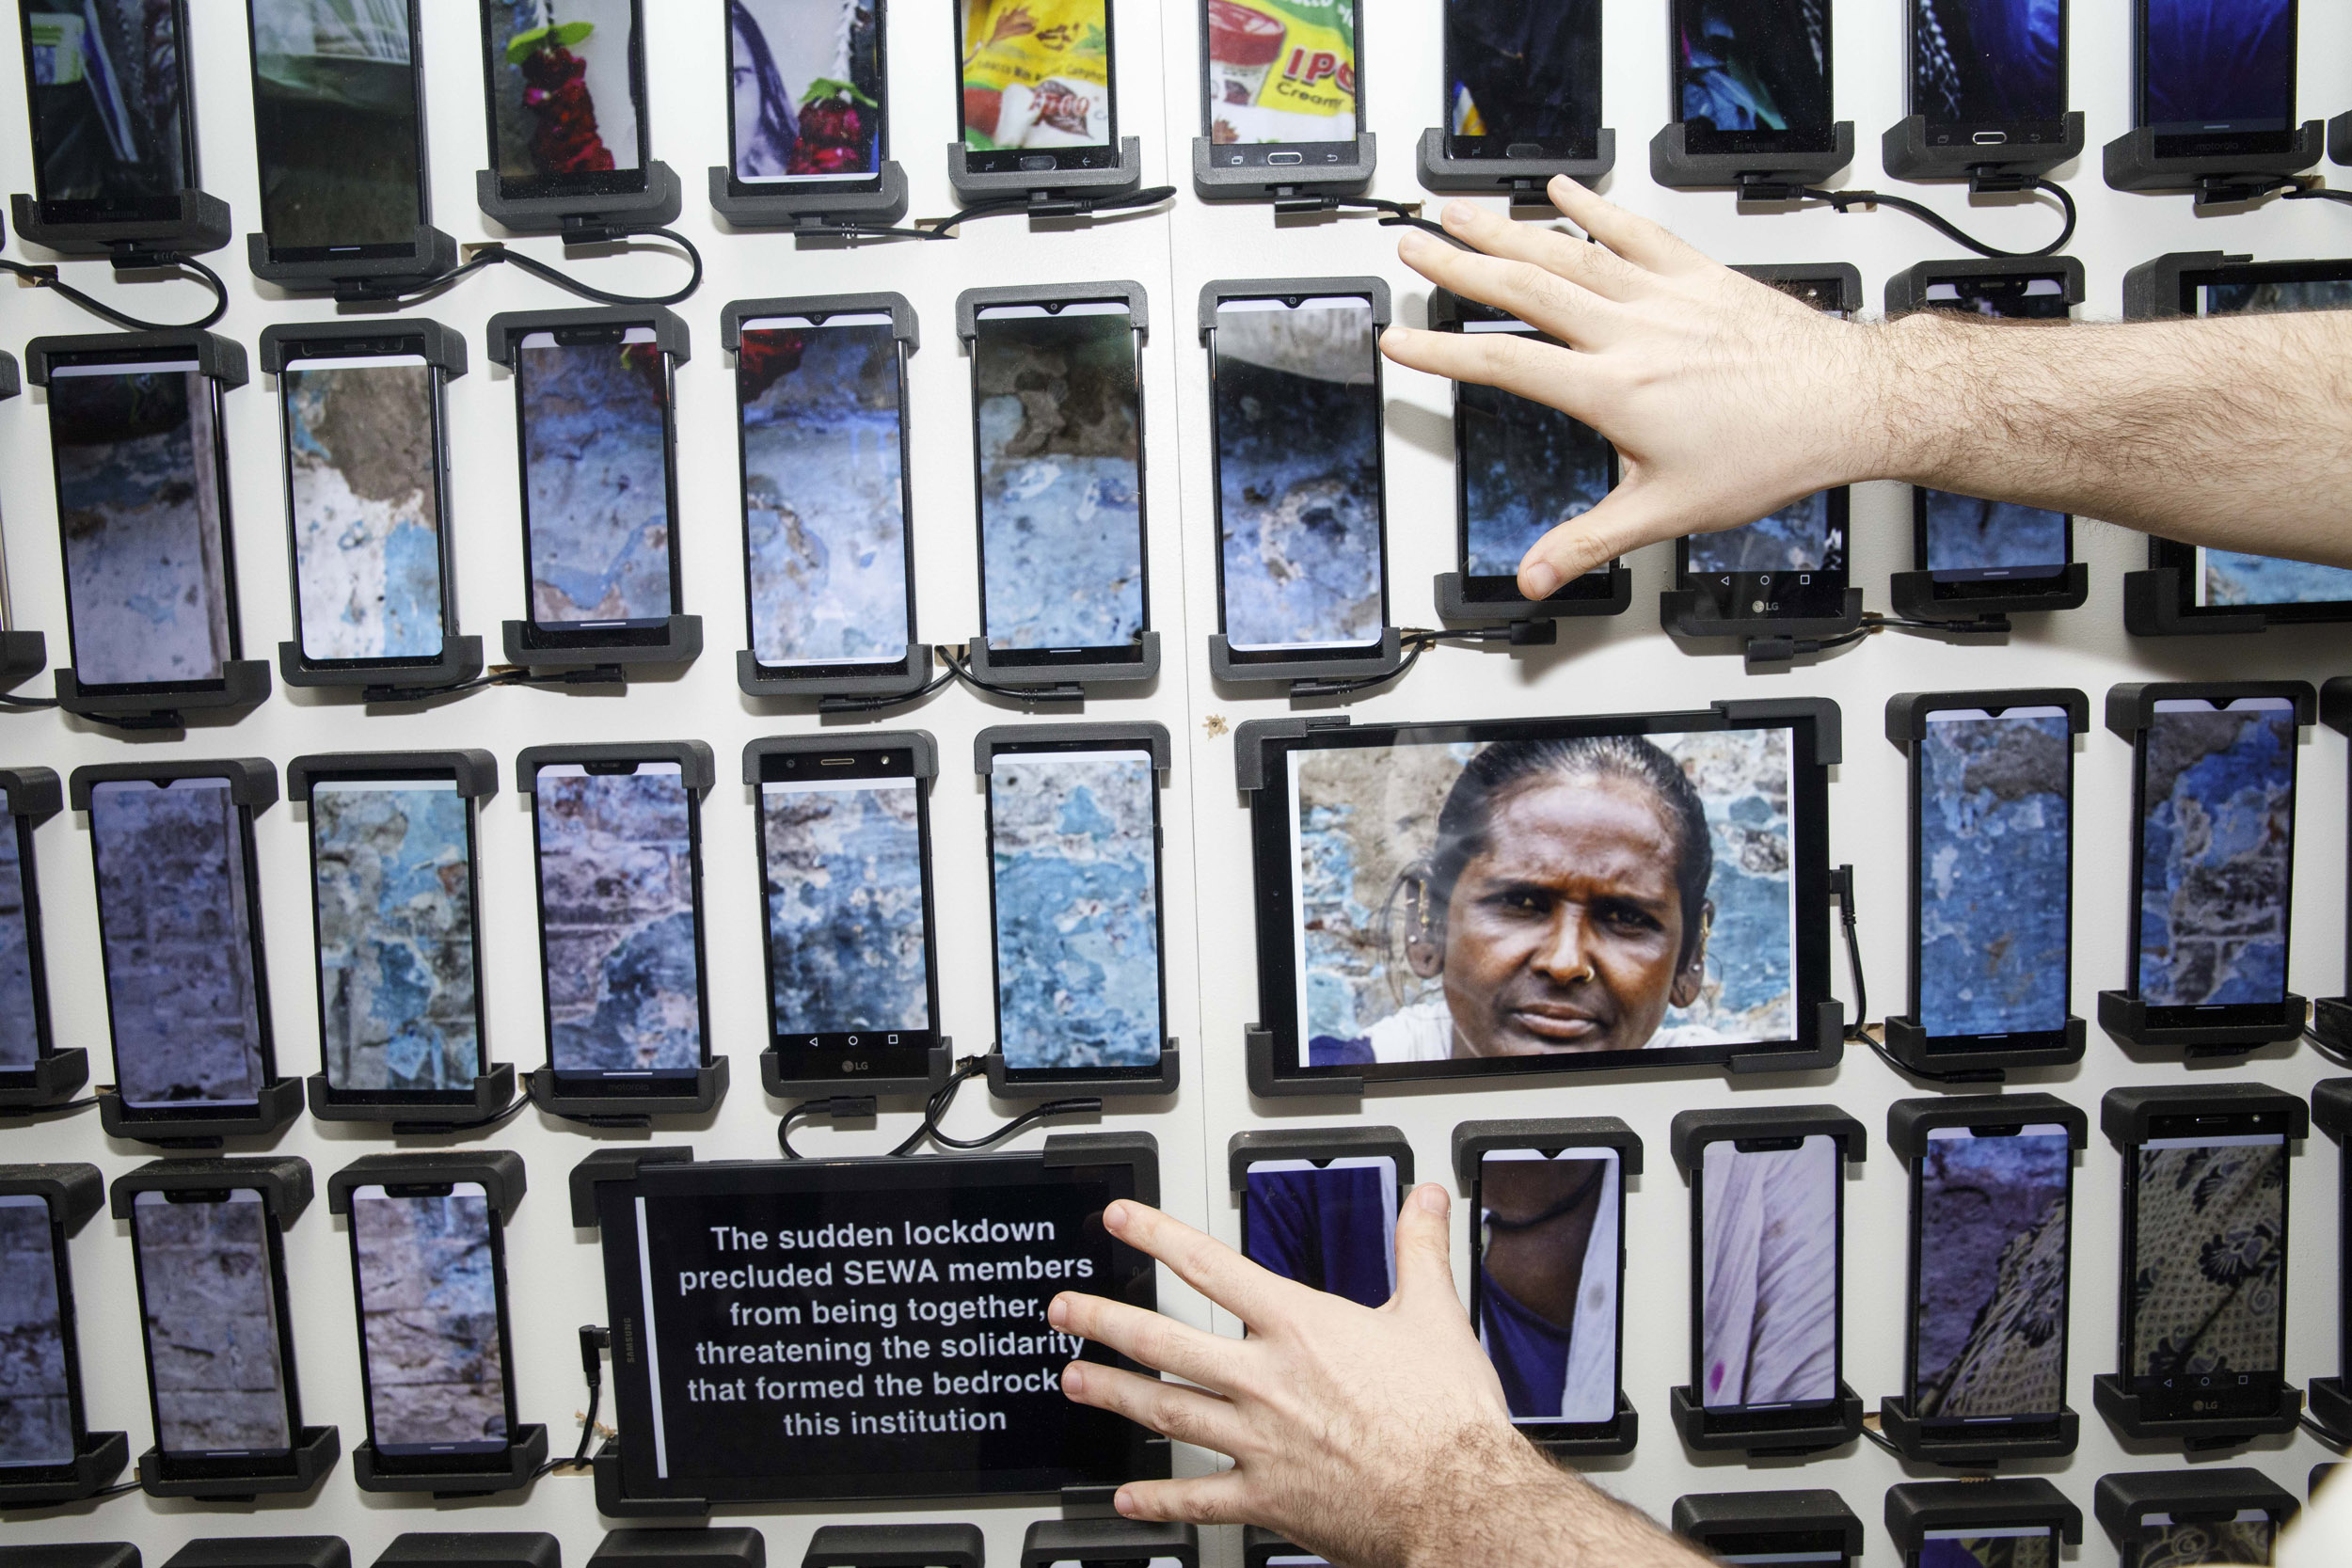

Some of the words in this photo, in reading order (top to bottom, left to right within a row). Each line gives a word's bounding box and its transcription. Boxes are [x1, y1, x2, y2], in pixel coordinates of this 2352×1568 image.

[2196, 142, 2239, 151] motorola
[608, 1082, 649, 1092] motorola
[709, 1226, 769, 1251] The
[779, 1222, 894, 1249] sudden
[904, 1218, 1055, 1245] lockdown
[679, 1261, 833, 1296] precluded
[844, 1258, 939, 1286] SEWA
[948, 1255, 1093, 1282] members
[729, 1302, 802, 1326] from
[812, 1298, 898, 1329] being
[907, 1293, 1046, 1324] together,
[623, 1317, 635, 1363] SAMSUNG
[695, 1337, 872, 1367] threatening
[881, 1335, 930, 1360] the
[940, 1331, 1085, 1359] solidarity
[687, 1378, 747, 1402] that
[755, 1373, 865, 1401] formed
[874, 1372, 923, 1397] the
[933, 1367, 1060, 1395] bedrock
[783, 1412, 840, 1436] this
[850, 1407, 1007, 1434] institution
